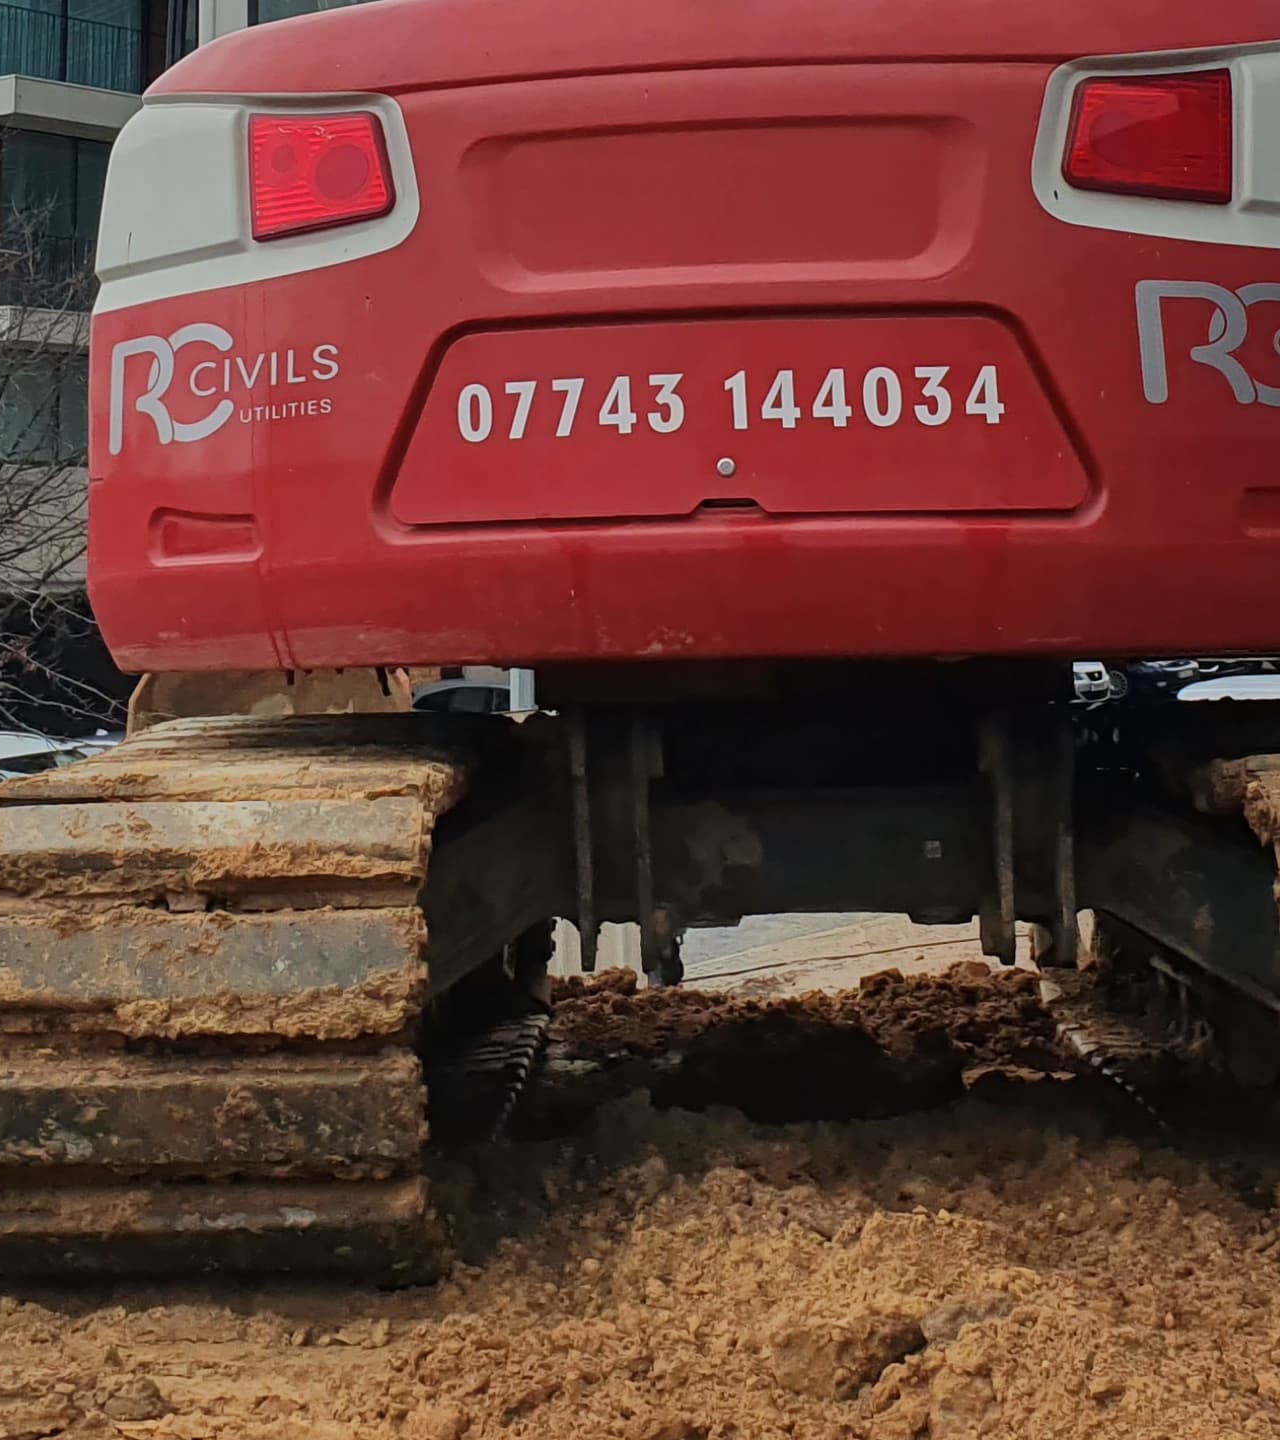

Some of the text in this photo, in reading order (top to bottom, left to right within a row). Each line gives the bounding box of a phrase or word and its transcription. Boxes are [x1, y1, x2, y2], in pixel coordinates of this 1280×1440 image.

[109, 322, 340, 456] RC CIVILS
[239, 398, 333, 424] UTILITIES
[456, 364, 1006, 443] 07743 144034
